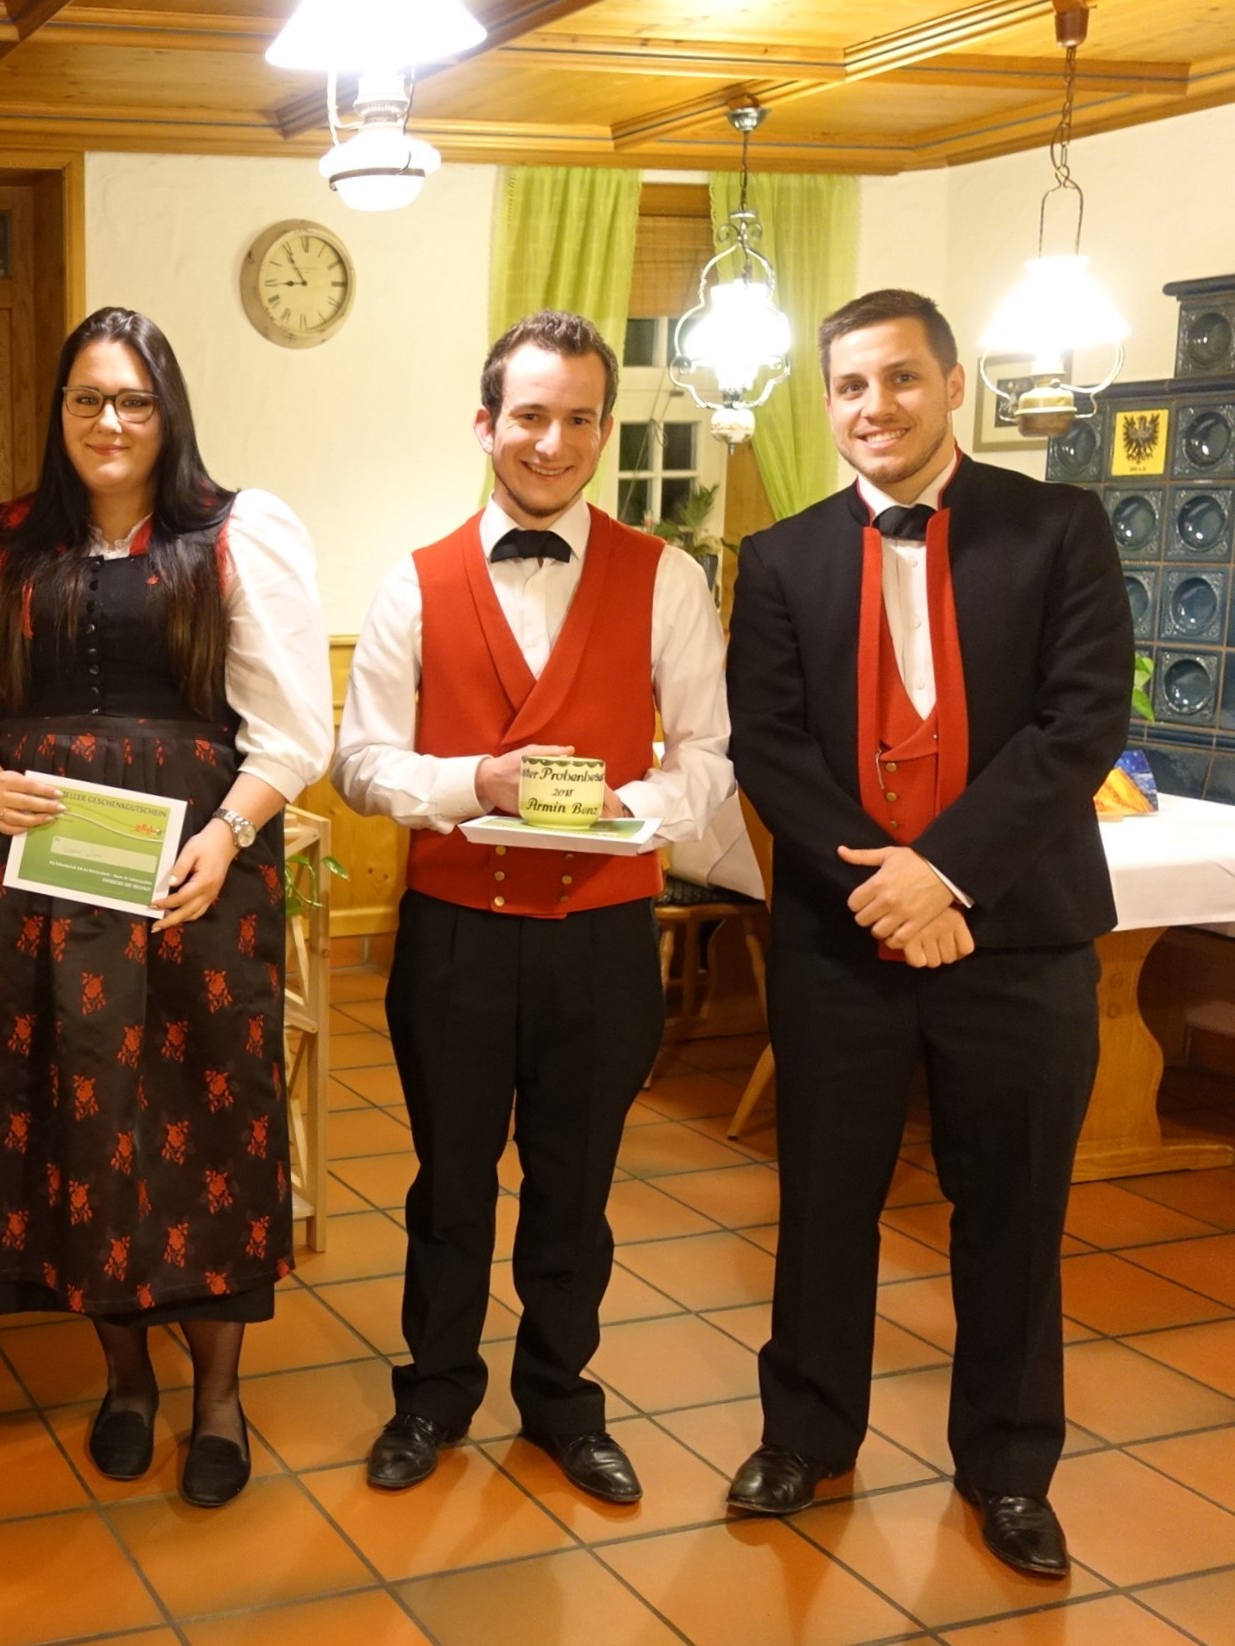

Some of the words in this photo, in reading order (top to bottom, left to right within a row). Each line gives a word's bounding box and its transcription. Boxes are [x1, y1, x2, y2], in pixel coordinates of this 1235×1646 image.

[552, 788, 574, 797] 2018
[88, 796, 167, 817] GESCHENKGUTSCHEIN
[526, 797, 566, 813] Armin
[571, 802, 598, 815] Benz
